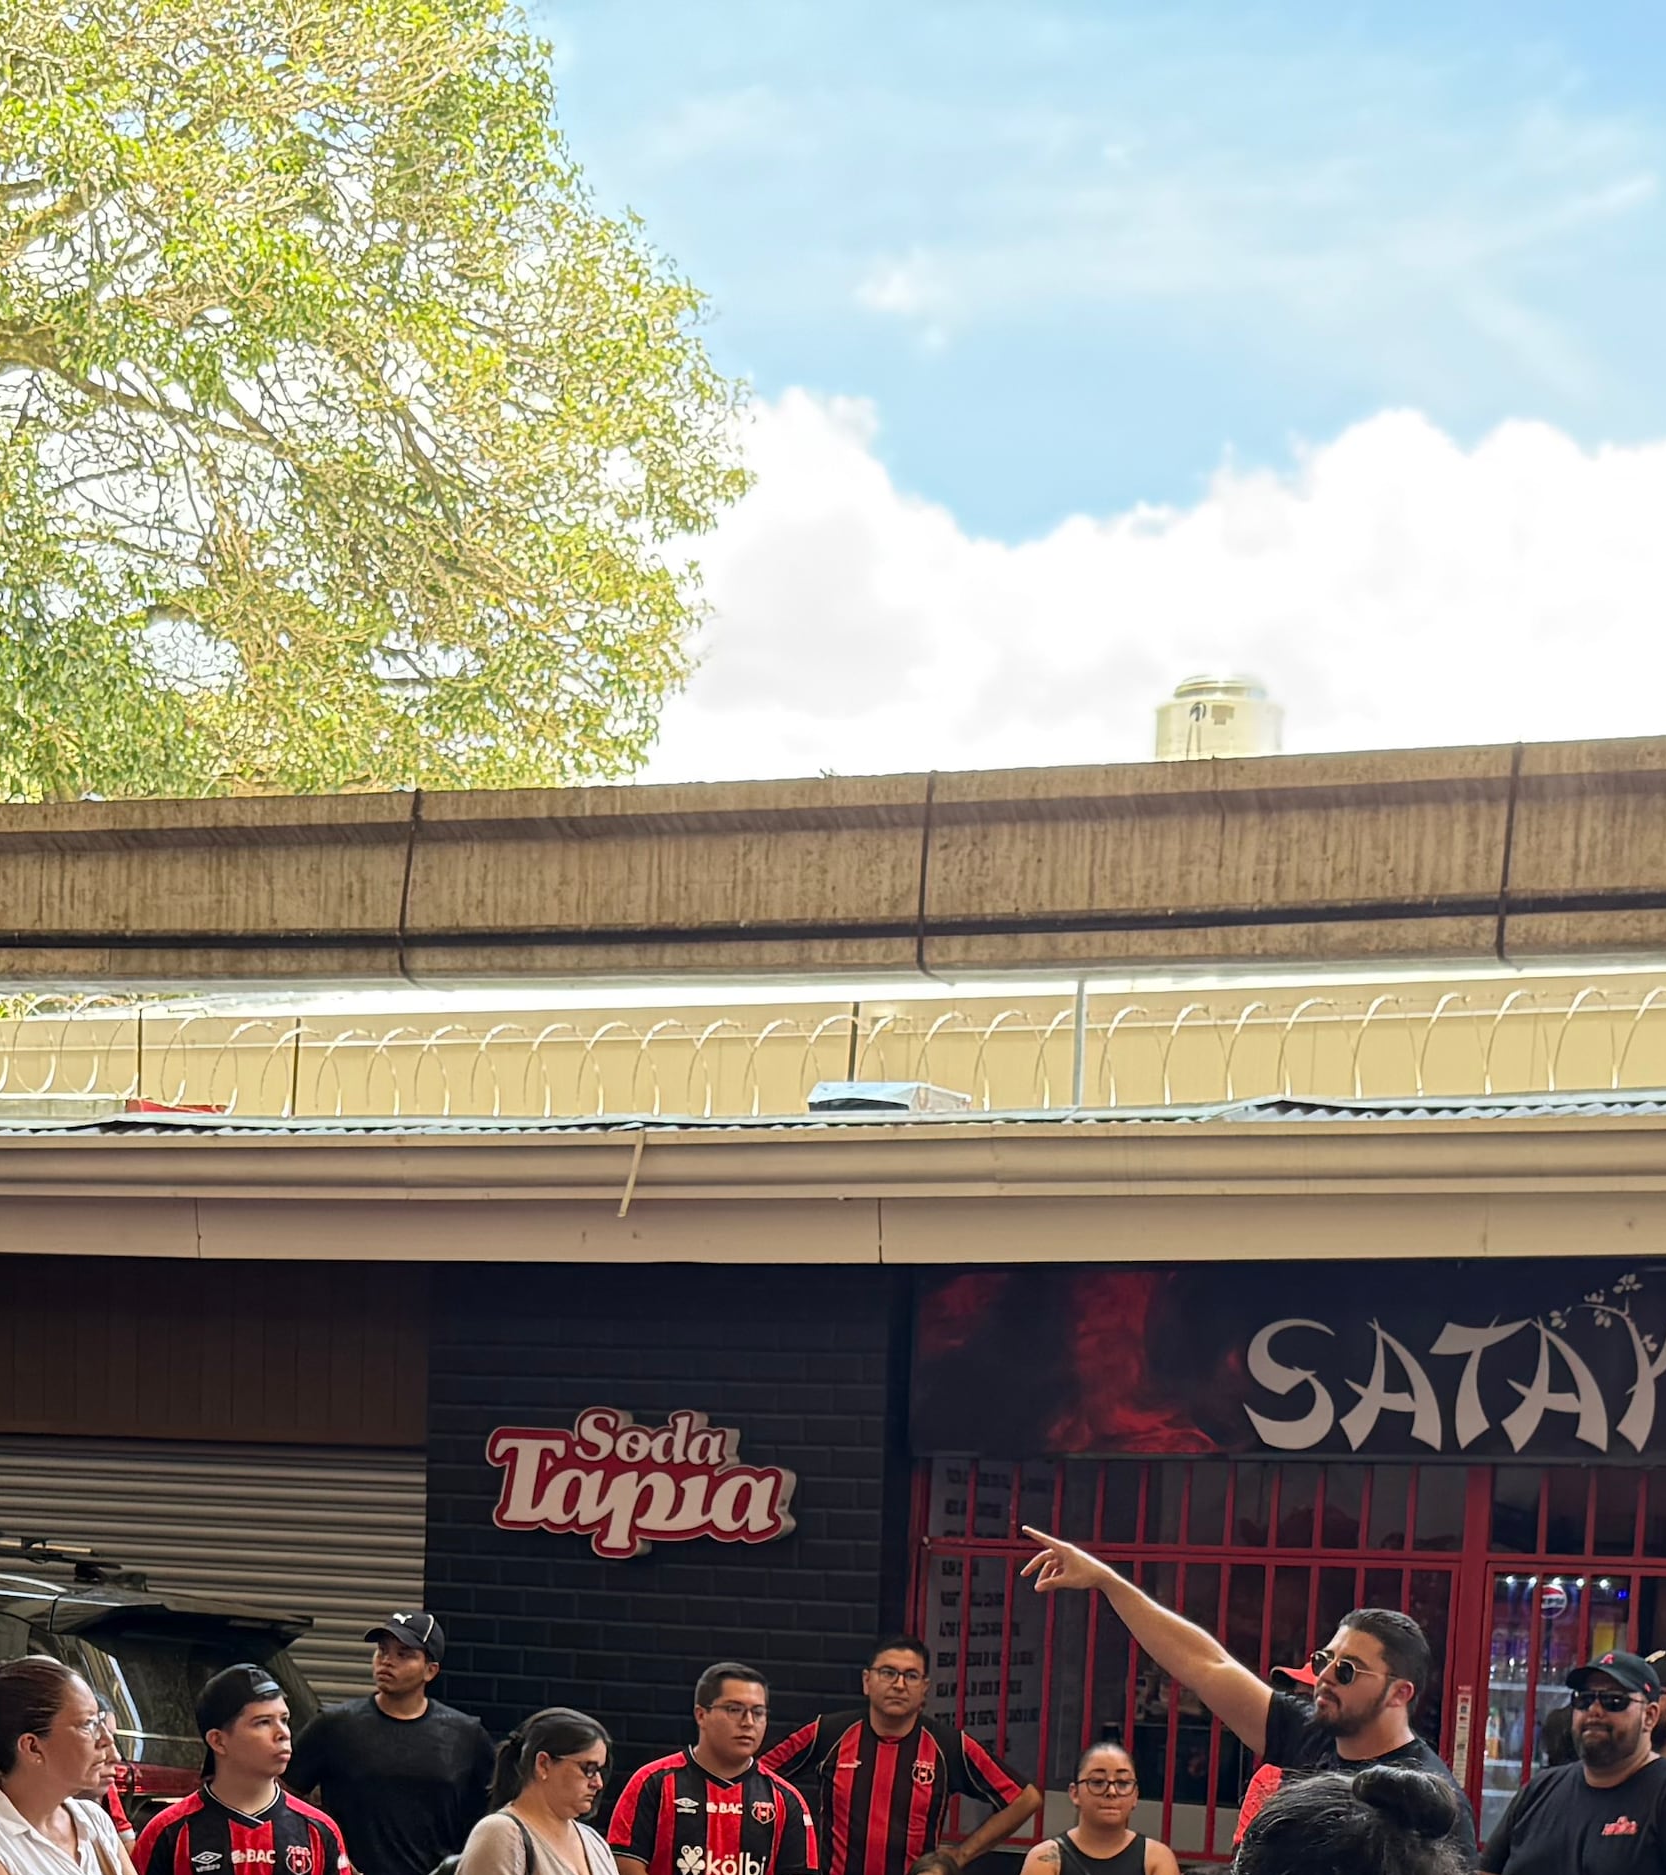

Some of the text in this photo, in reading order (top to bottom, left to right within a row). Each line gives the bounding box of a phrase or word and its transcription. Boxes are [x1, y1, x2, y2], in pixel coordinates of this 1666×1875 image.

[575, 1412, 725, 1466] Soda
[718, 1802, 744, 1815] BAC
[245, 1848, 276, 1864] BAC
